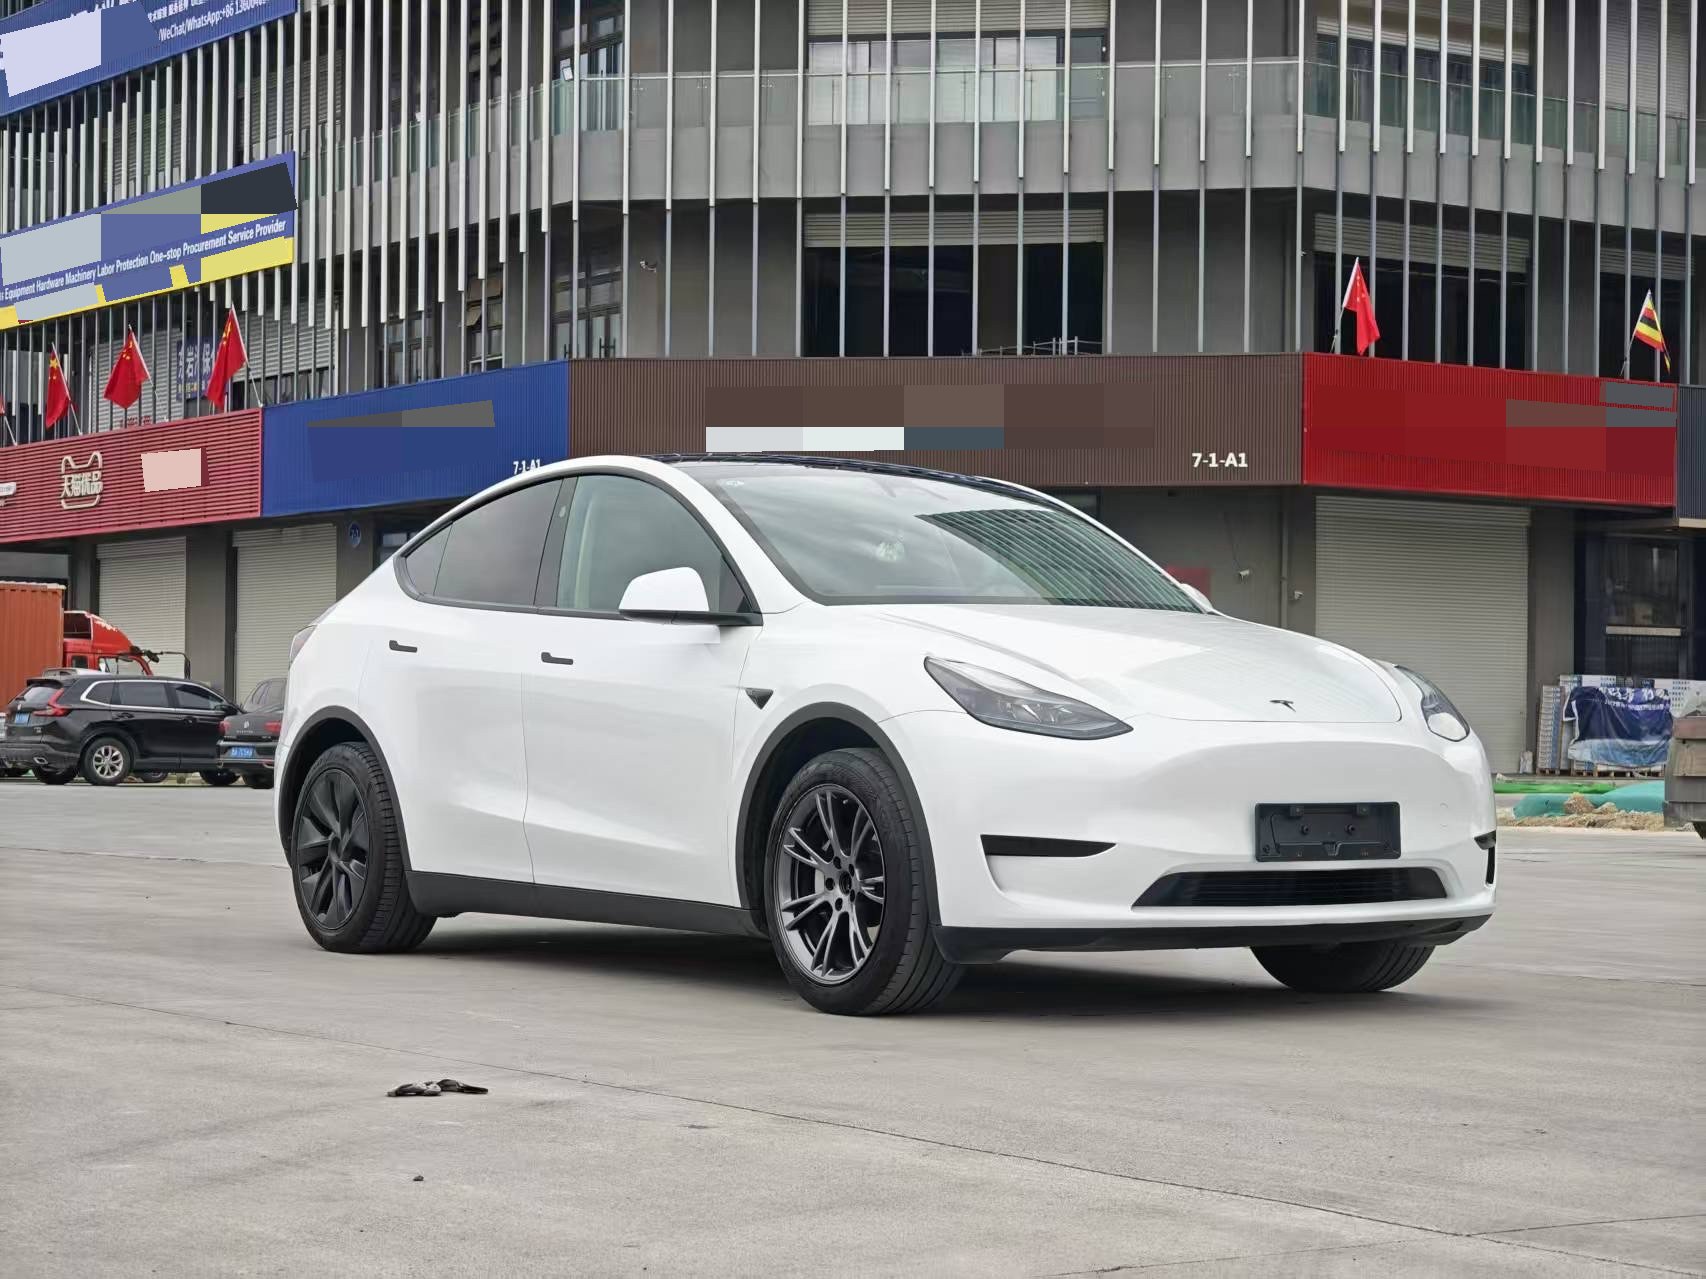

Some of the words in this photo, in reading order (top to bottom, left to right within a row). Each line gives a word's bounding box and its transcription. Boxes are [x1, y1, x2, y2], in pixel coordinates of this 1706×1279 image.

[4, 284, 36, 301] Equipment
[36, 276, 65, 292] Hardware
[65, 268, 97, 286] Machinery
[97, 262, 116, 278] Labor
[116, 253, 149, 272] Protection
[149, 246, 182, 264] One-stop
[183, 234, 228, 257] Procurement
[228, 227, 255, 245] Service
[255, 218, 287, 238] Provider
[1192, 452, 1248, 468] 7-1-A1
